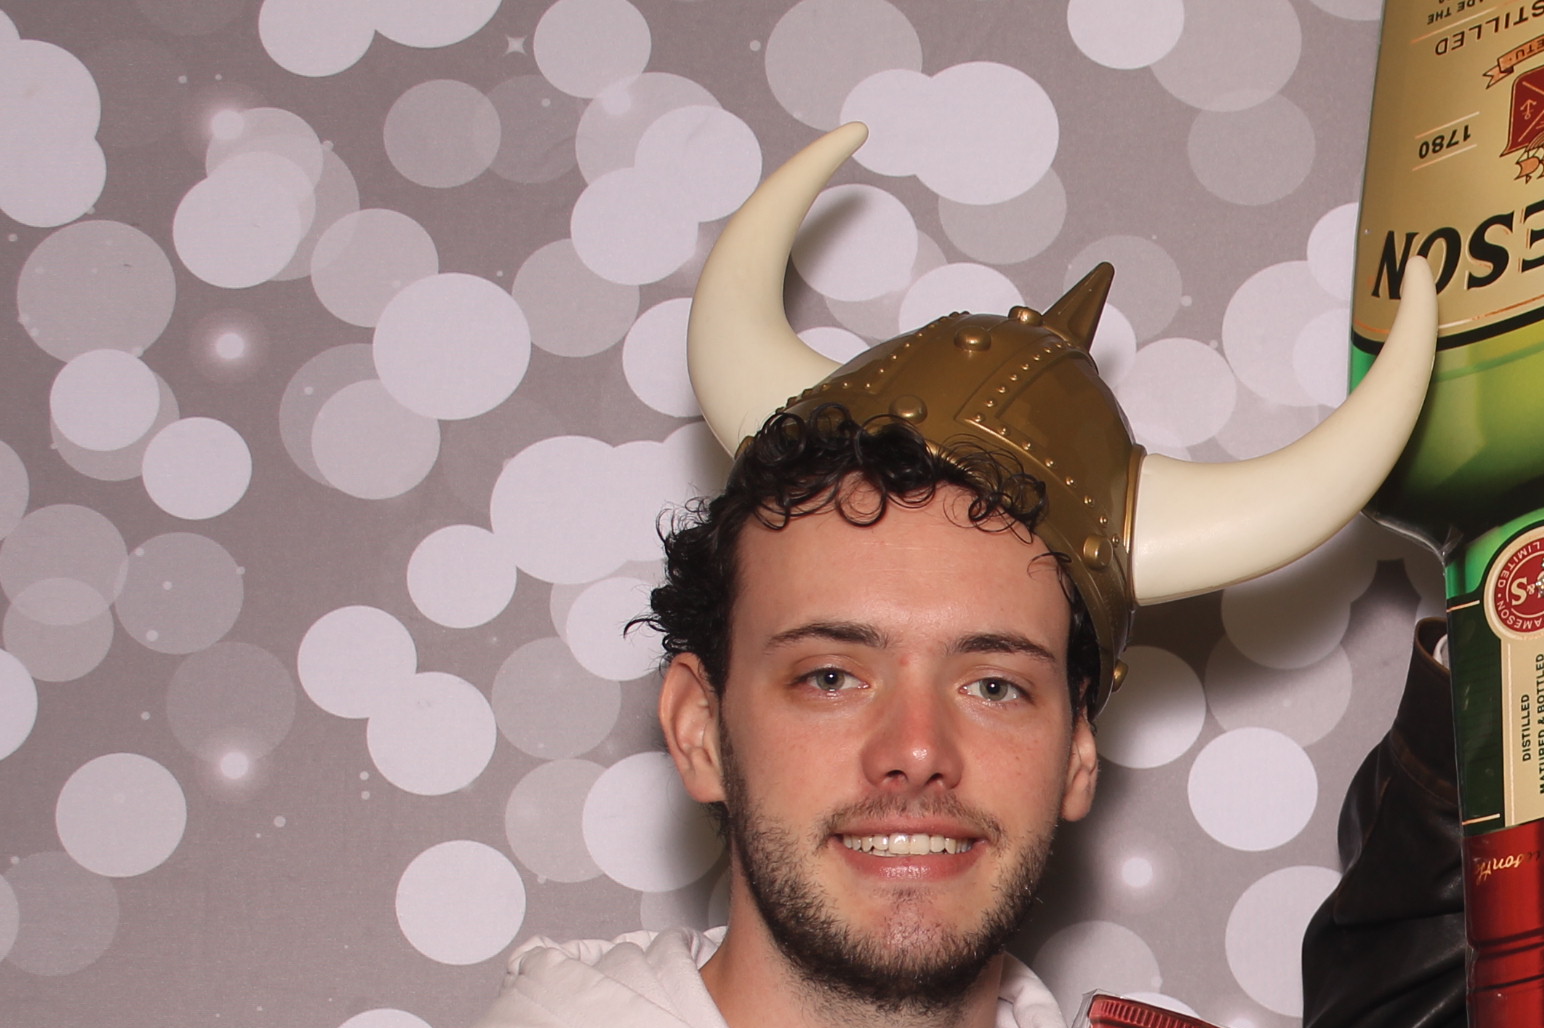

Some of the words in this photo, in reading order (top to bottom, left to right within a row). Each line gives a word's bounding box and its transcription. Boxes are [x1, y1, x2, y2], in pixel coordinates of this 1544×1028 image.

[1426, 7, 1453, 26] THE
[1418, 124, 1472, 160] 1780
[1497, 542, 1541, 588] LIMITED
[1520, 693, 1532, 763] DISTILLED
